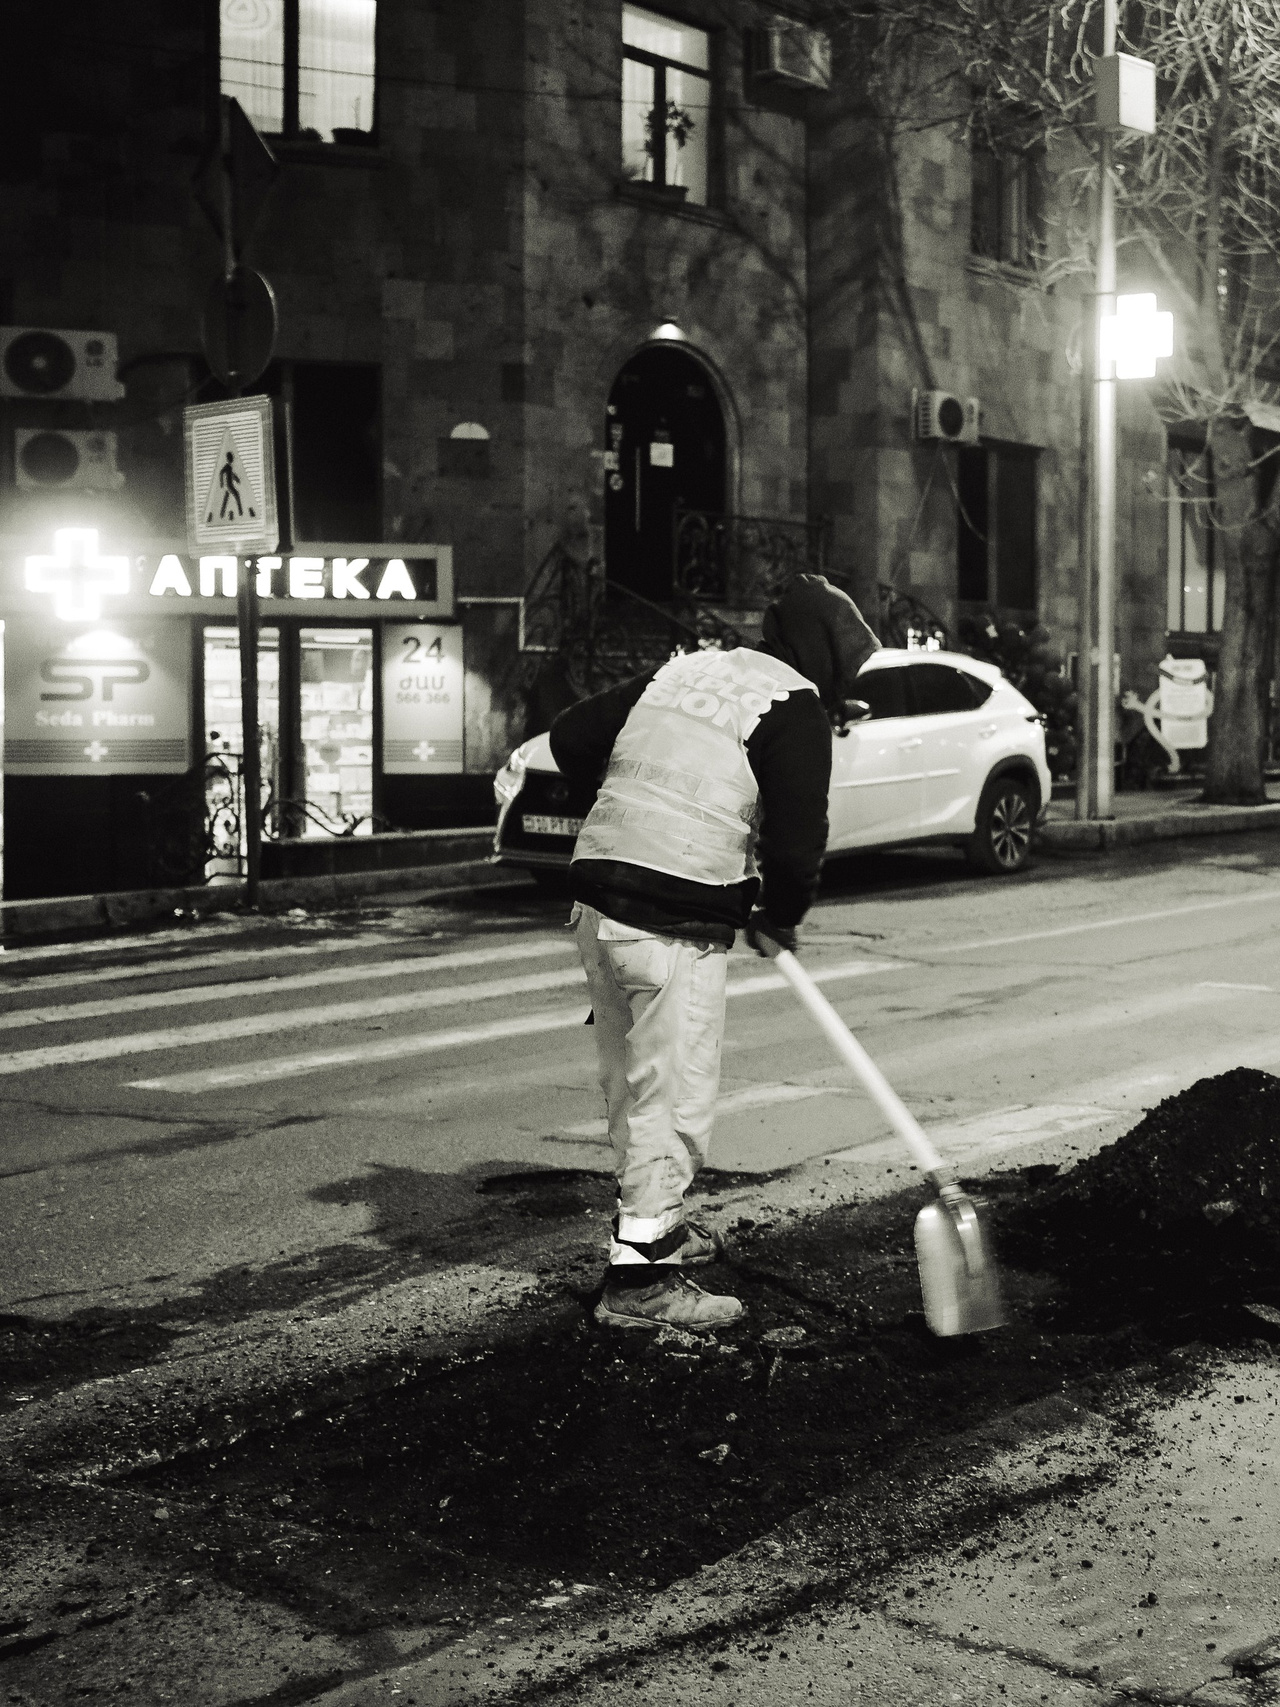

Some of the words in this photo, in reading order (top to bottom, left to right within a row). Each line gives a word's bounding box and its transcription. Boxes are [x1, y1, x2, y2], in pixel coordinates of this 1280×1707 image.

[149, 554, 417, 600] АПТЕКА
[402, 636, 445, 663] 24
[40, 659, 150, 701] SP
[35, 709, 83, 727] Seda
[92, 710, 154, 727] Pharm
